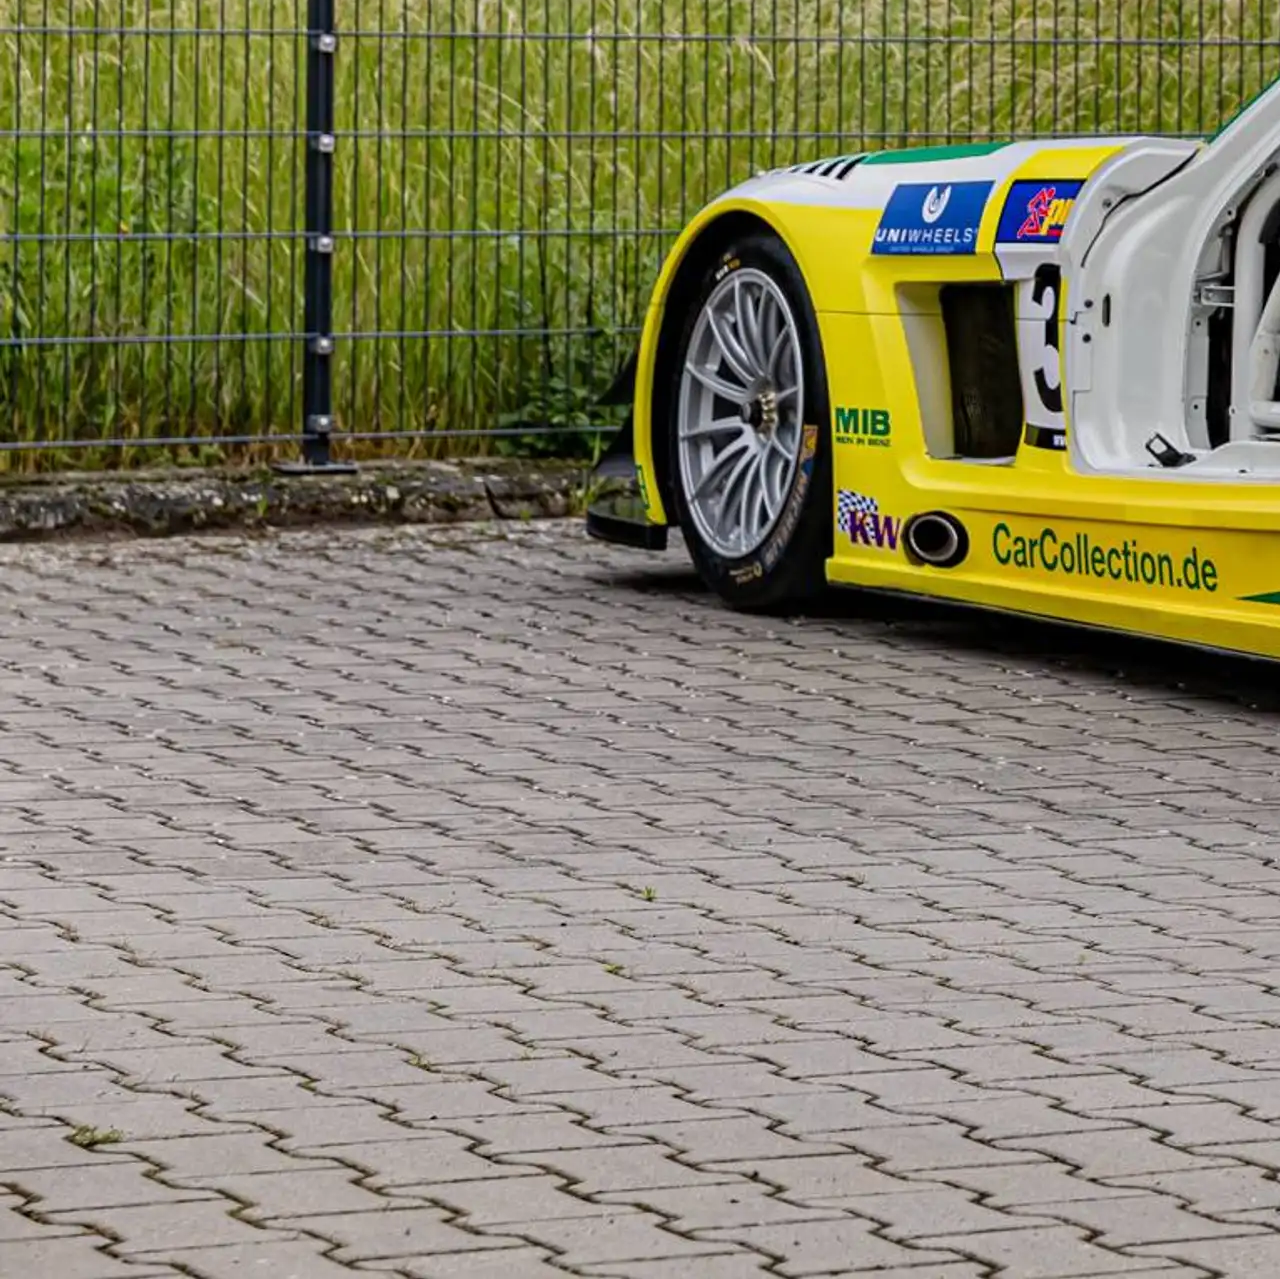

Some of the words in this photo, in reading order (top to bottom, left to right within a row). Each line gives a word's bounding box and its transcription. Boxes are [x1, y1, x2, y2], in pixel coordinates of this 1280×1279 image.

[875, 227, 973, 244] UNIWHEELS
[835, 407, 891, 436] MIB
[849, 509, 900, 550] KW
[992, 522, 1219, 592] CarCollection.de
